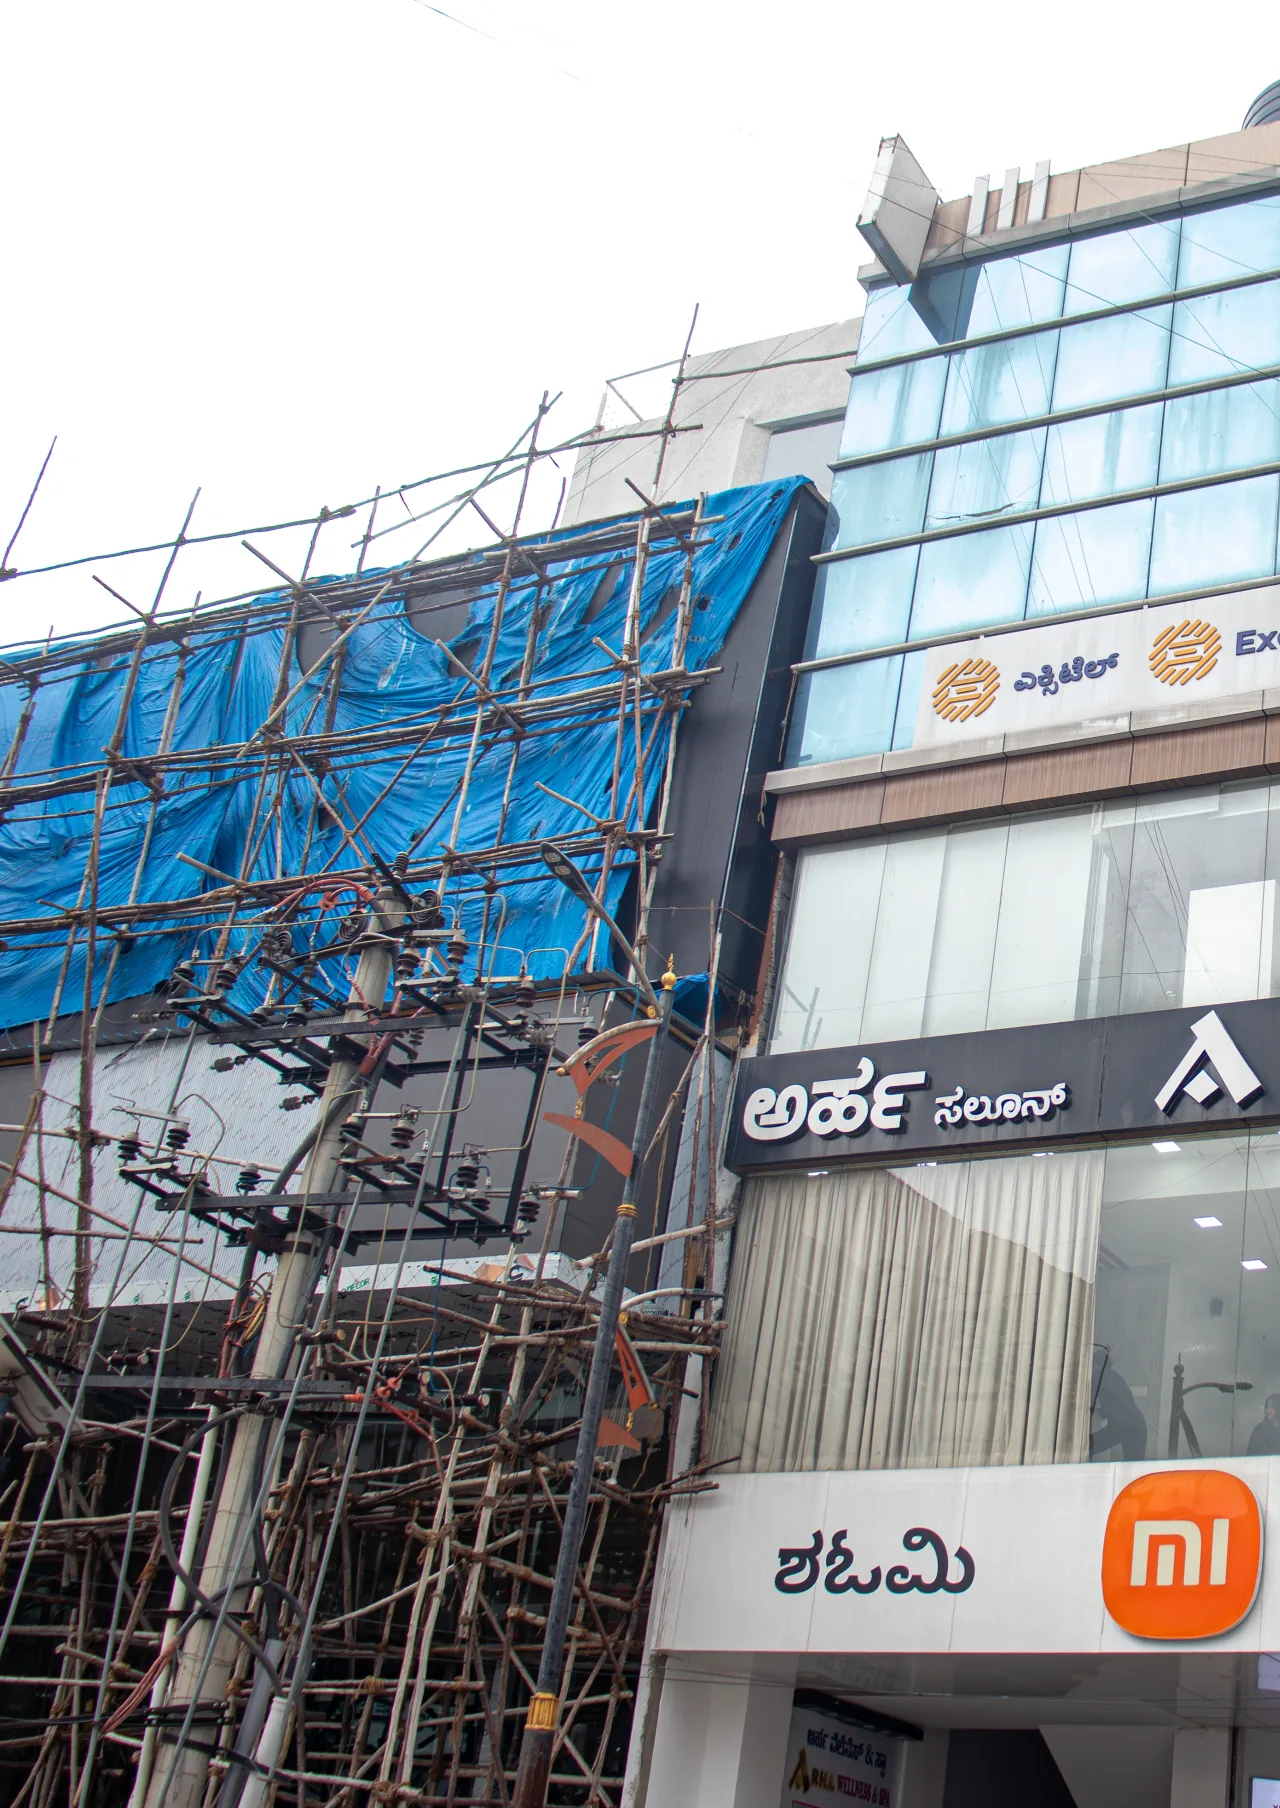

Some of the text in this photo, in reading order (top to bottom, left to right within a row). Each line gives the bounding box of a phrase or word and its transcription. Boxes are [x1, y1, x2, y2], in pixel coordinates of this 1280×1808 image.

[1013, 651, 1120, 697] ಎಕ್ಸಿಟೆಲ್
[743, 1056, 1067, 1142] ಅರ್ಹ ಸಲೂನ್
[865, 1744, 874, 1766] &
[837, 1774, 871, 1802] WELLNESS
